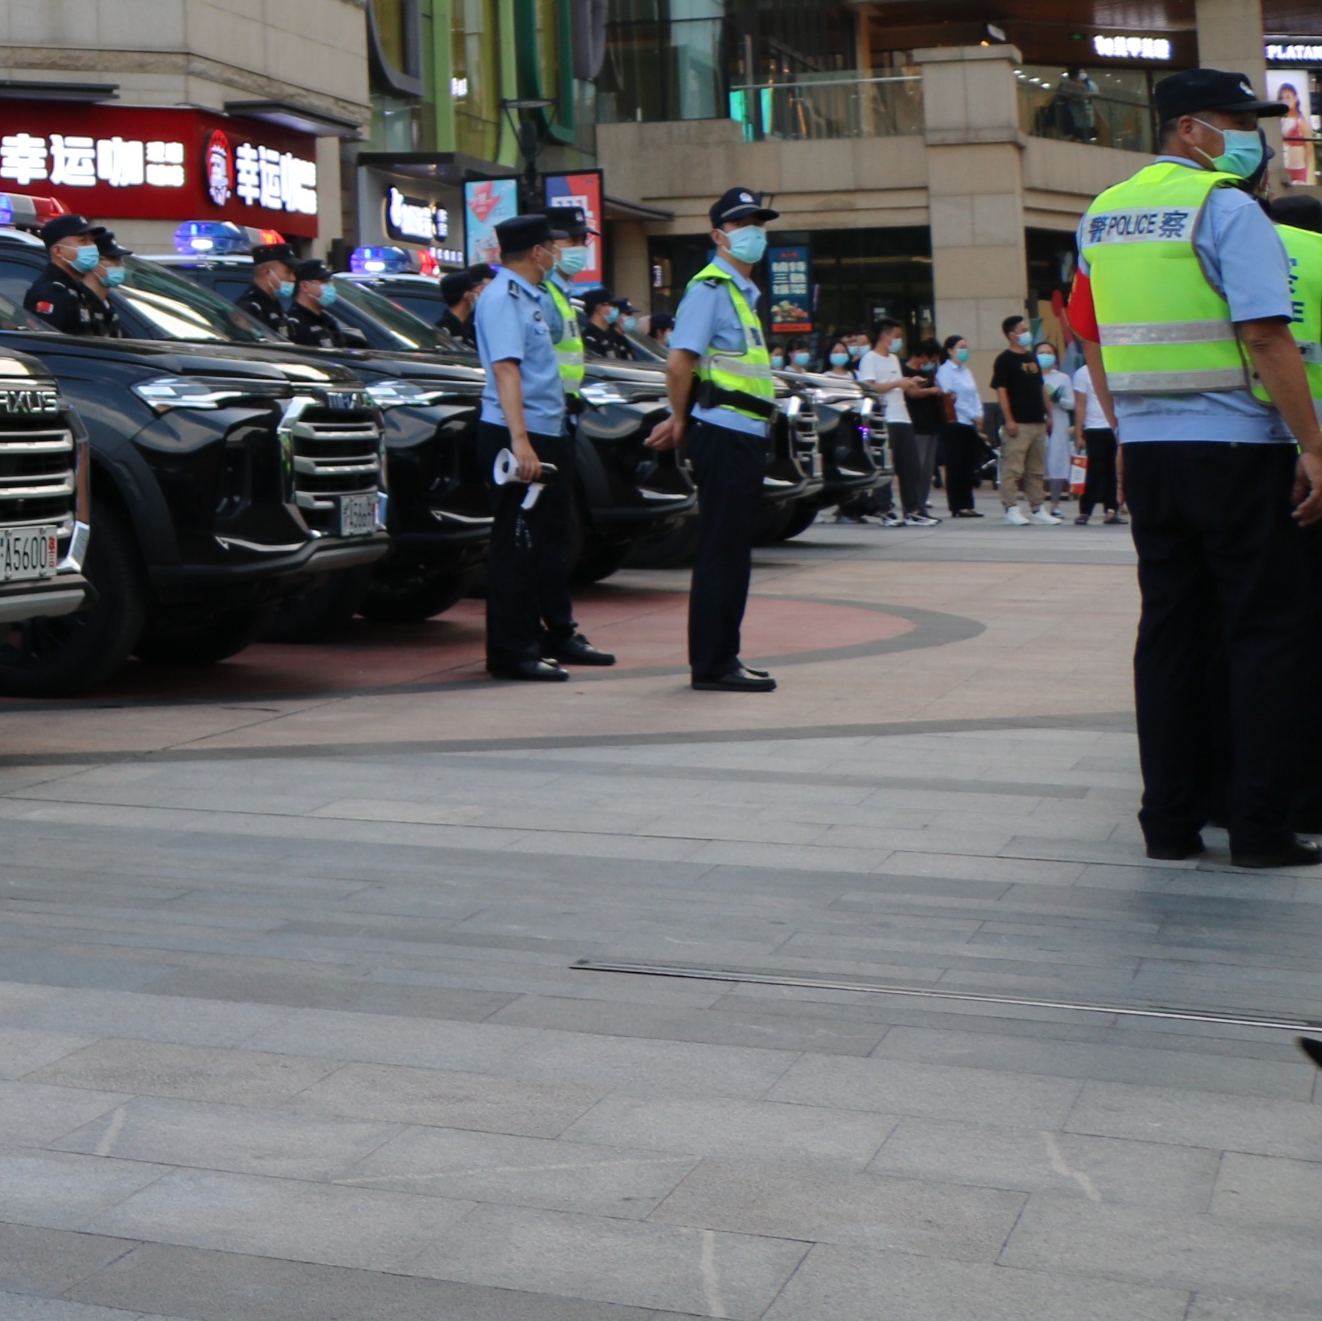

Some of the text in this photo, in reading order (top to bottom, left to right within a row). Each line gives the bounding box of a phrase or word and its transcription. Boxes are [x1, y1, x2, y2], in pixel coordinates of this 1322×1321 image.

[0, 132, 145, 188] 幸运咖
[1089, 210, 1189, 242] 警 POLICE 察
